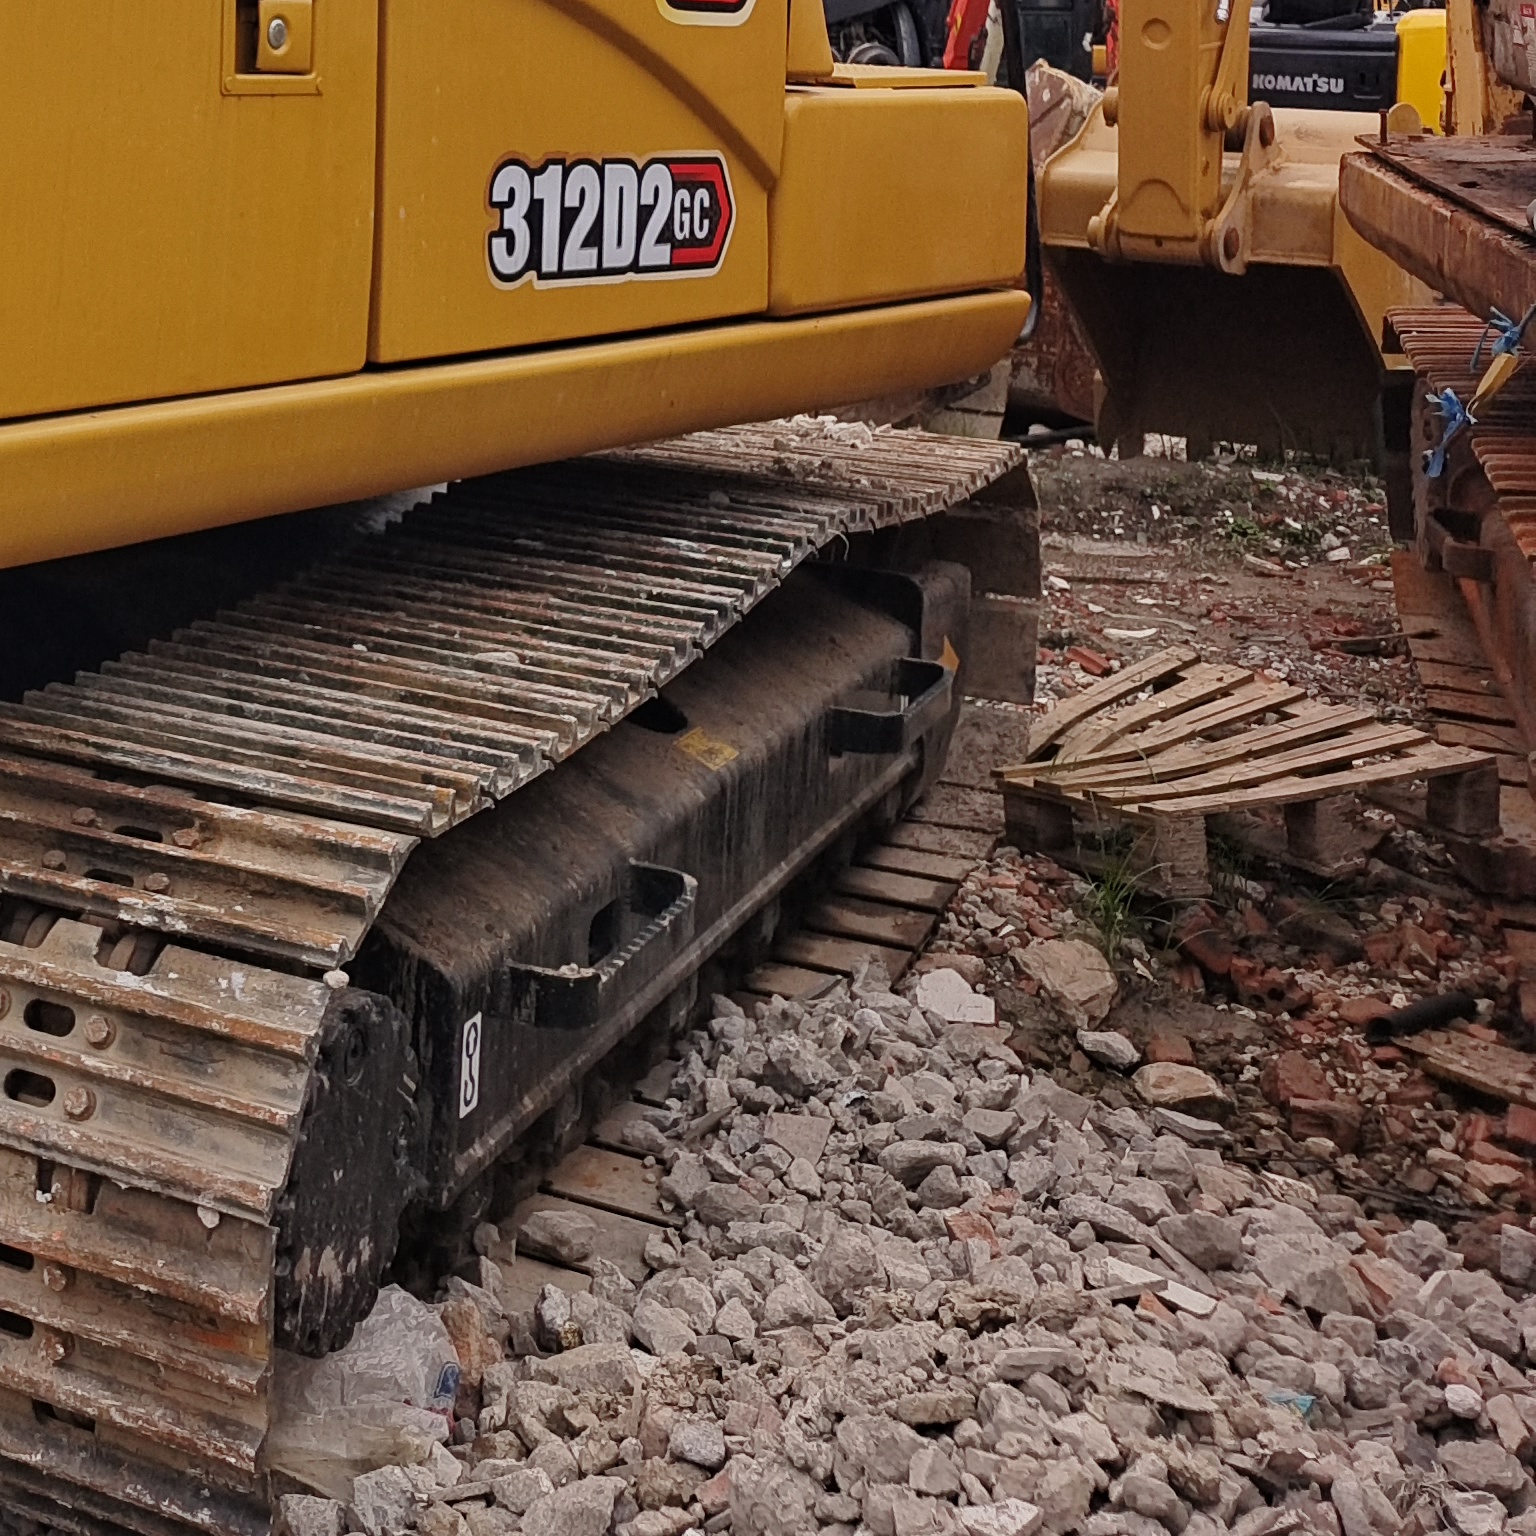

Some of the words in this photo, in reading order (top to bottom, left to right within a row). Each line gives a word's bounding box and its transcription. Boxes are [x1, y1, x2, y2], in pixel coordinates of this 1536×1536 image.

[1251, 72, 1345, 94] KOMATSU
[491, 163, 673, 275] 312D2
[673, 187, 711, 241] GC
